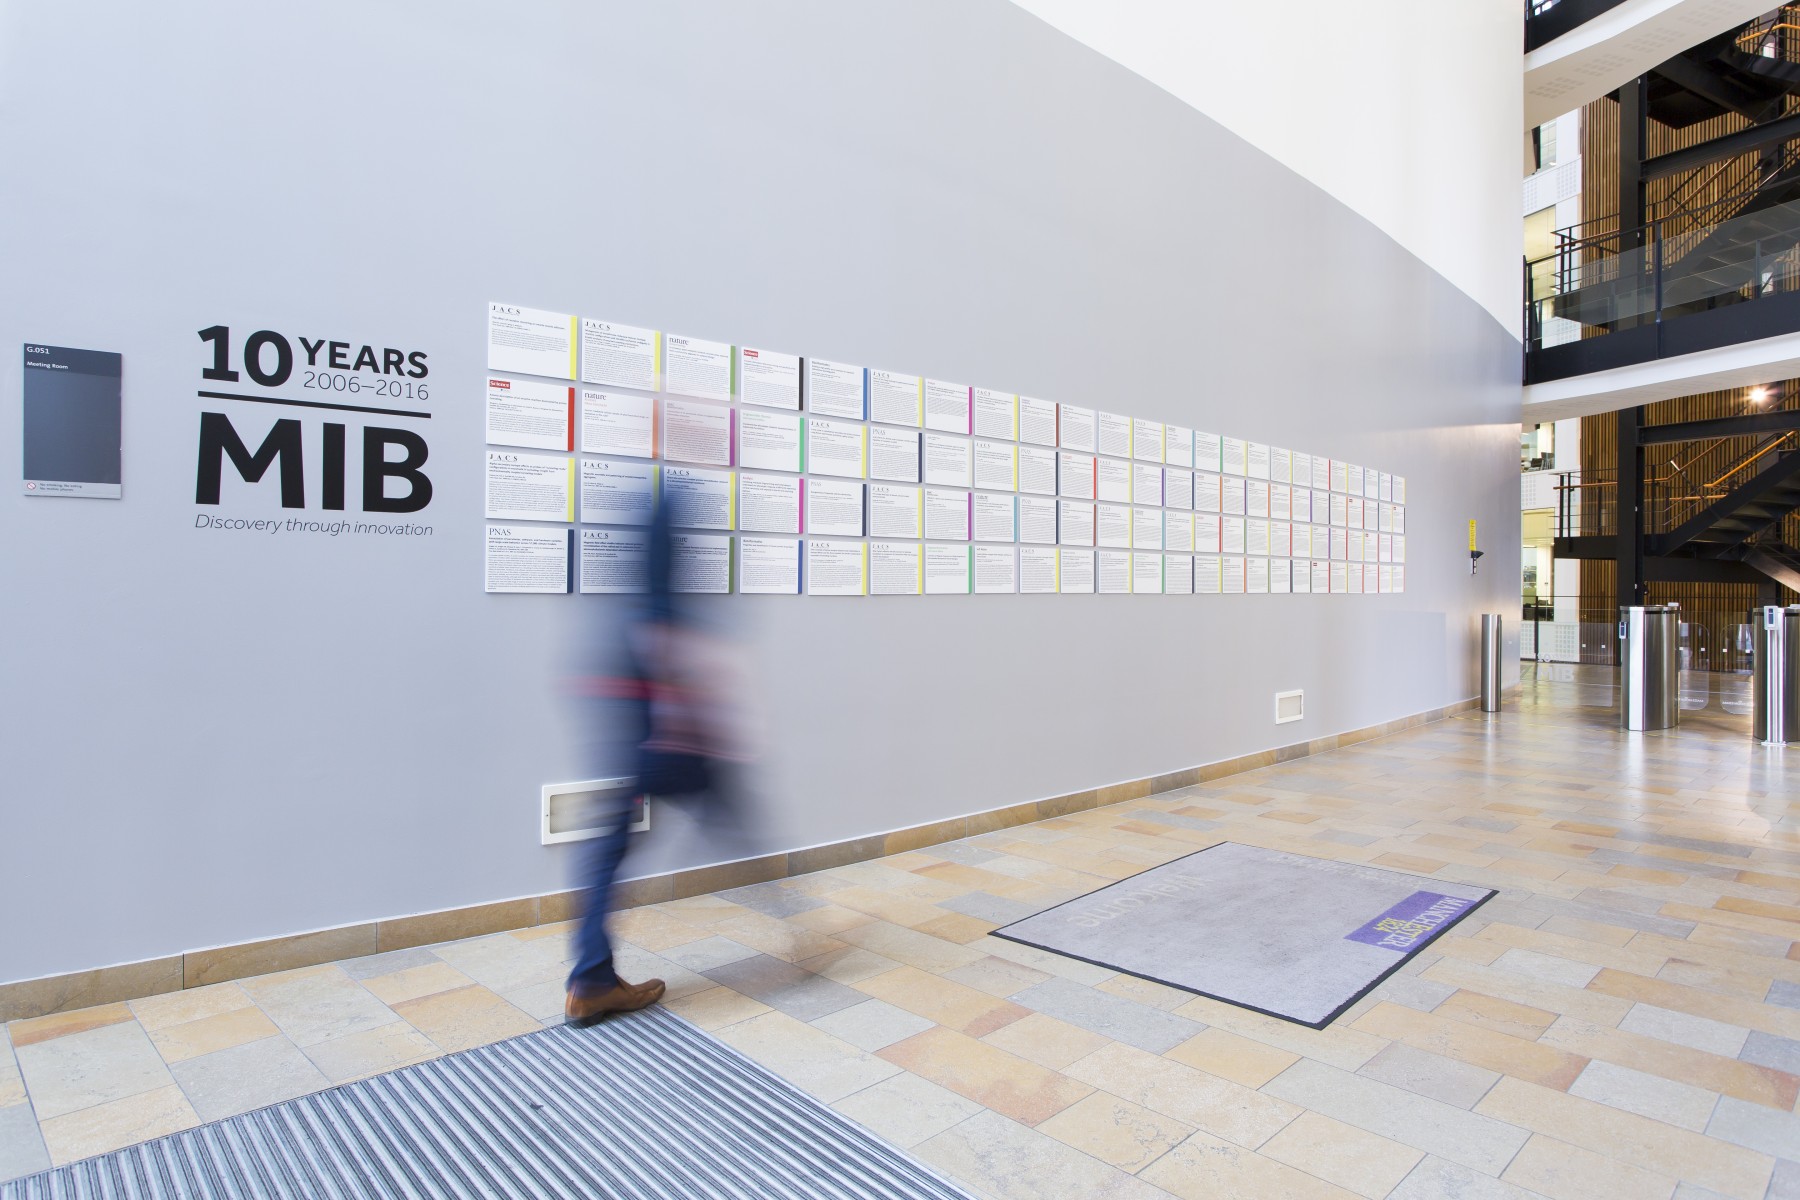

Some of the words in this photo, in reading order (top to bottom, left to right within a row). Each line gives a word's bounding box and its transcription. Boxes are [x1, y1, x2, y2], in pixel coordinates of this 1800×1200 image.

[26, 346, 50, 355] G.051
[26, 361, 51, 369] Meeting
[197, 325, 293, 387] 10
[298, 336, 429, 379] YEARS
[195, 411, 433, 513] MIB
[194, 513, 282, 534] Discovery
[286, 518, 351, 537] through
[353, 520, 434, 536] innovation
[1377, 896, 1468, 948] MANCHESTER
